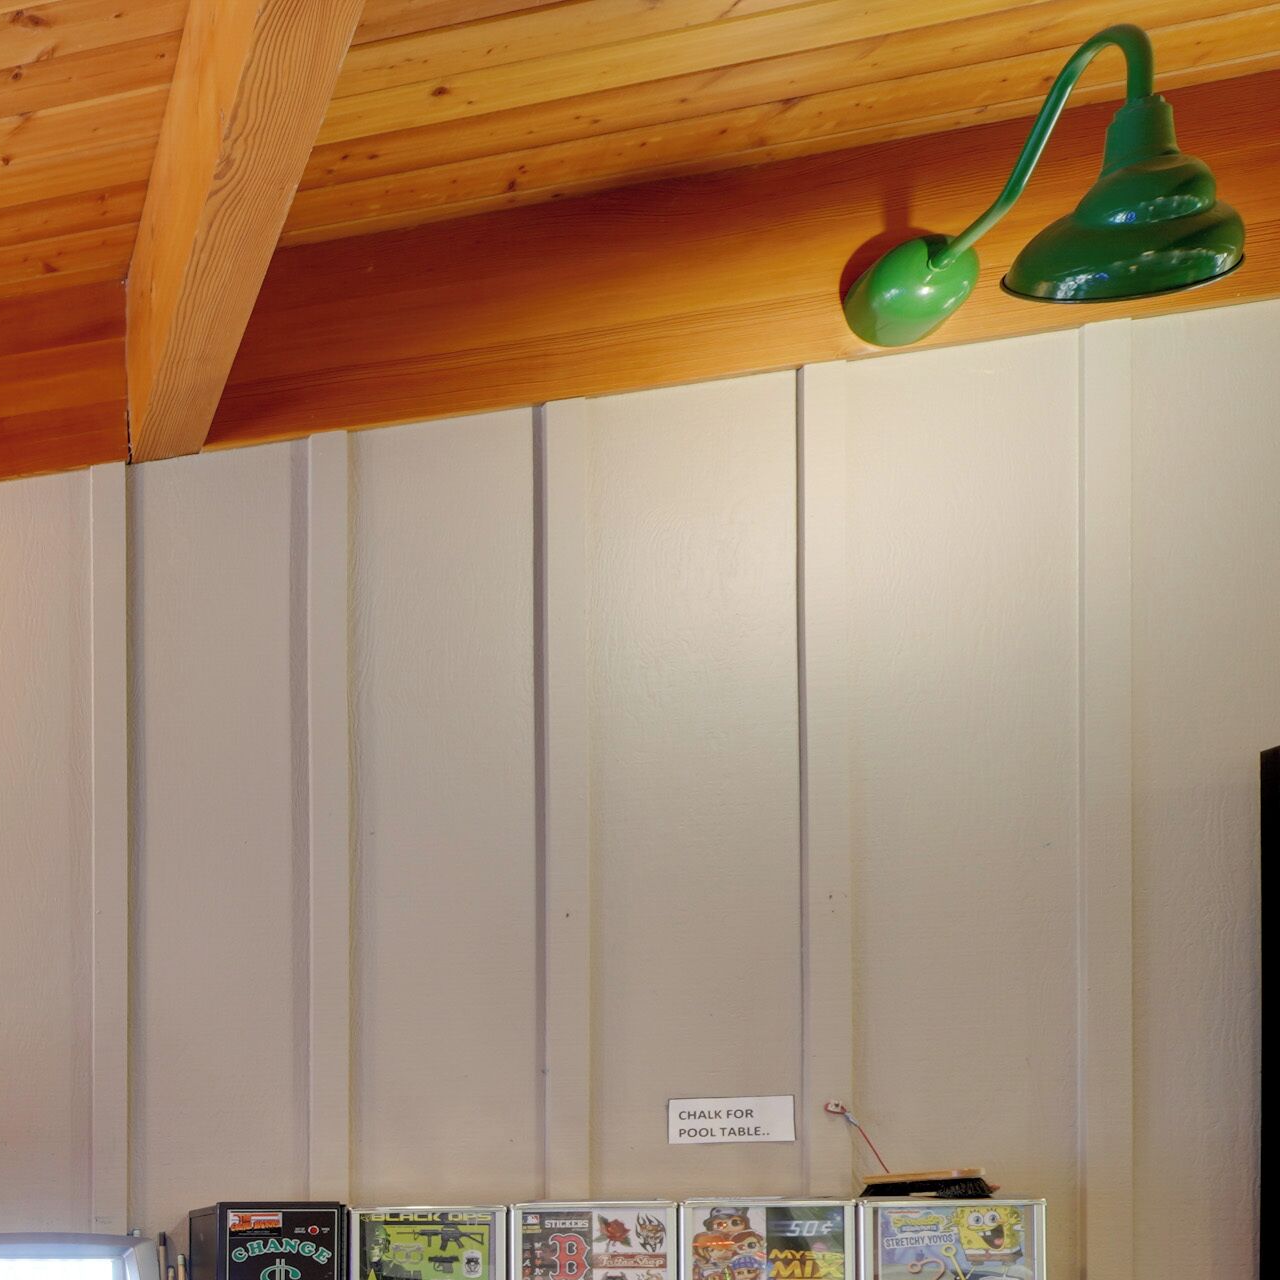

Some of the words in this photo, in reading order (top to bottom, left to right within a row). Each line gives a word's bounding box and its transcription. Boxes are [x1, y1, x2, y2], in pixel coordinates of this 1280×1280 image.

[678, 1110, 722, 1120] CHALK
[726, 1108, 754, 1119] FOR
[679, 1128, 716, 1138] POOL
[720, 1126, 770, 1137] TABLE..
[372, 1213, 442, 1221] BLACK
[448, 1213, 492, 1221] OPS
[545, 1220, 589, 1228] STICKERS
[787, 1220, 834, 1237] 50¢
[885, 1236, 925, 1248] STRETCHY
[928, 1234, 954, 1245] YOYOS
[231, 1237, 332, 1264] CHANGE
[636, 1256, 665, 1266] Shop
[769, 1260, 844, 1278] MIX
